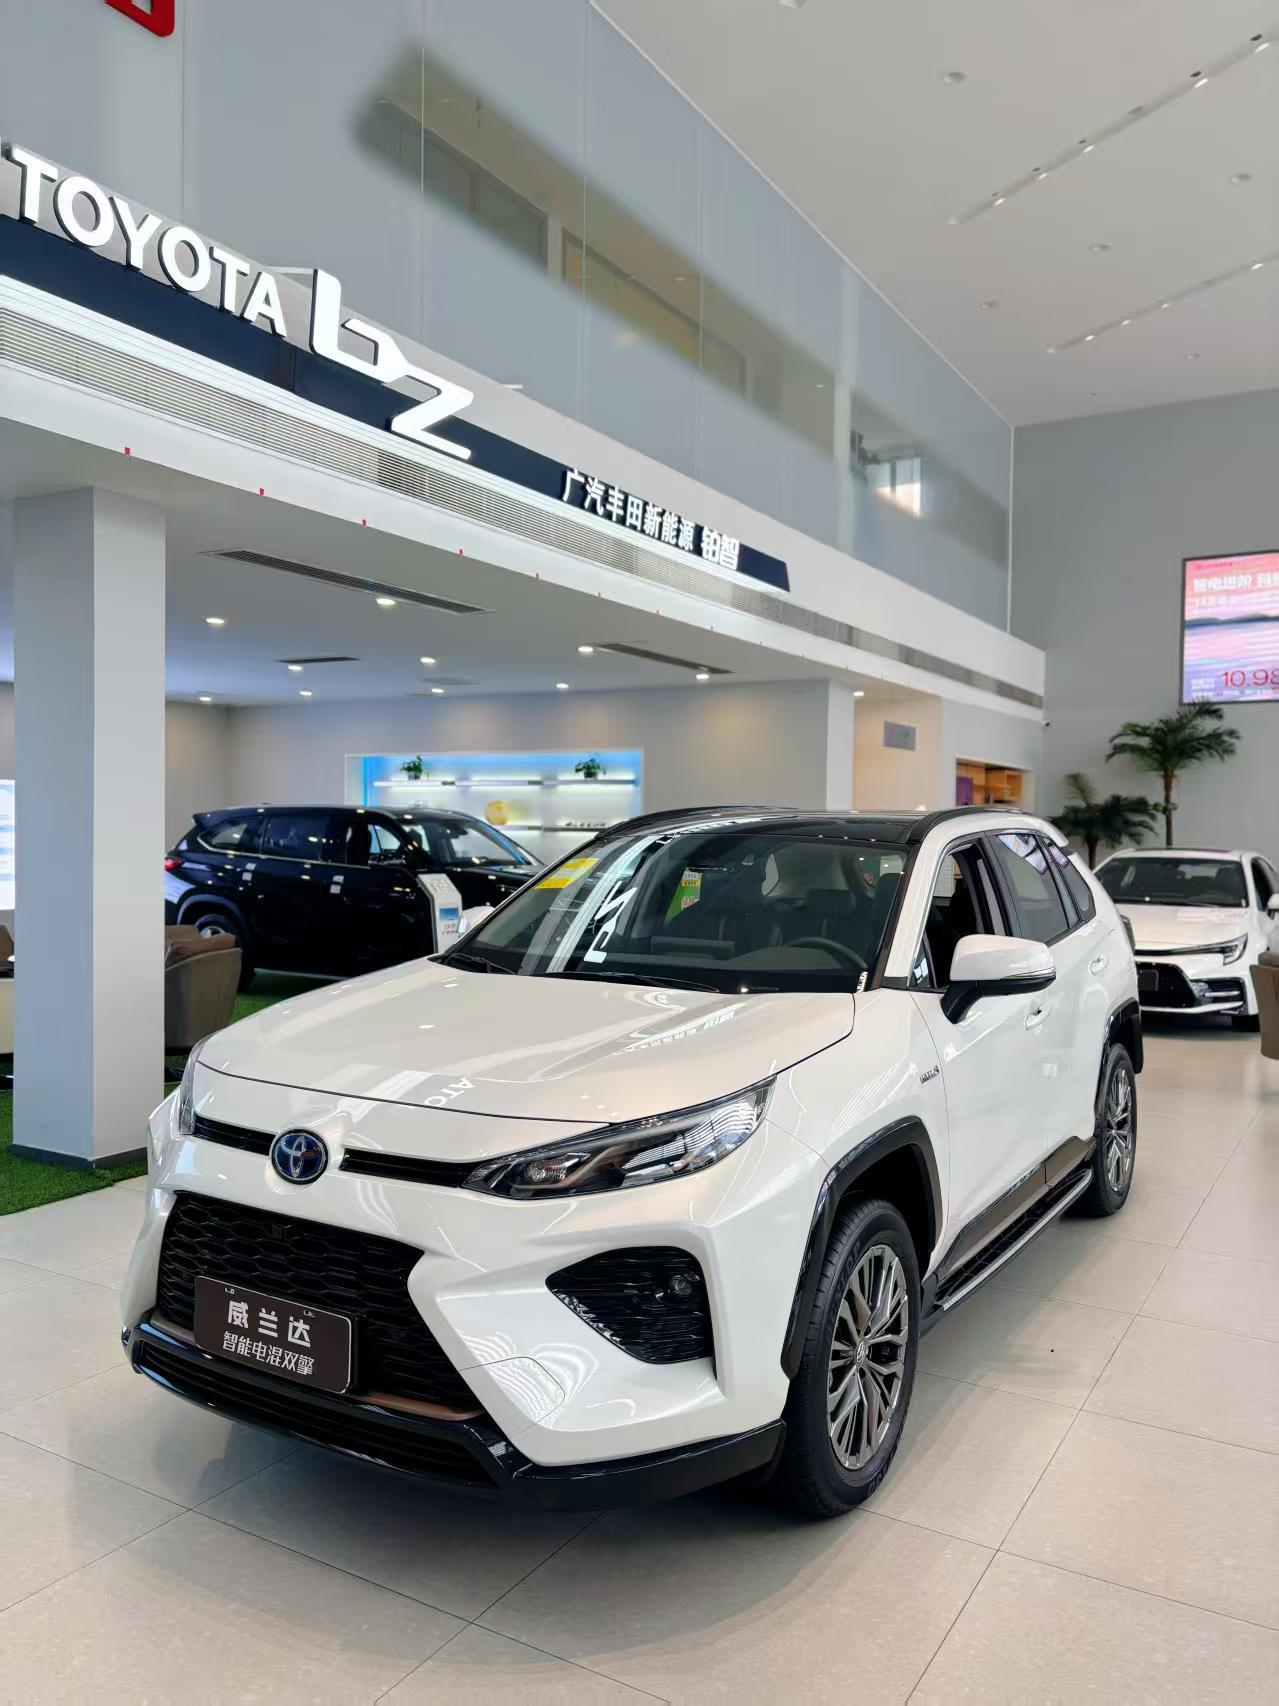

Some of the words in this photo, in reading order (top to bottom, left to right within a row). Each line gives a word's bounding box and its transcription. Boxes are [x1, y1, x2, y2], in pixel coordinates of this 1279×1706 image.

[11, 146, 287, 337] TOYOTA
[563, 469, 695, 551] 广汽丰田新能源
[701, 524, 740, 571] 铂智
[222, 1330, 315, 1376] 智能电混双擎
[227, 1300, 311, 1348] 威兰达
